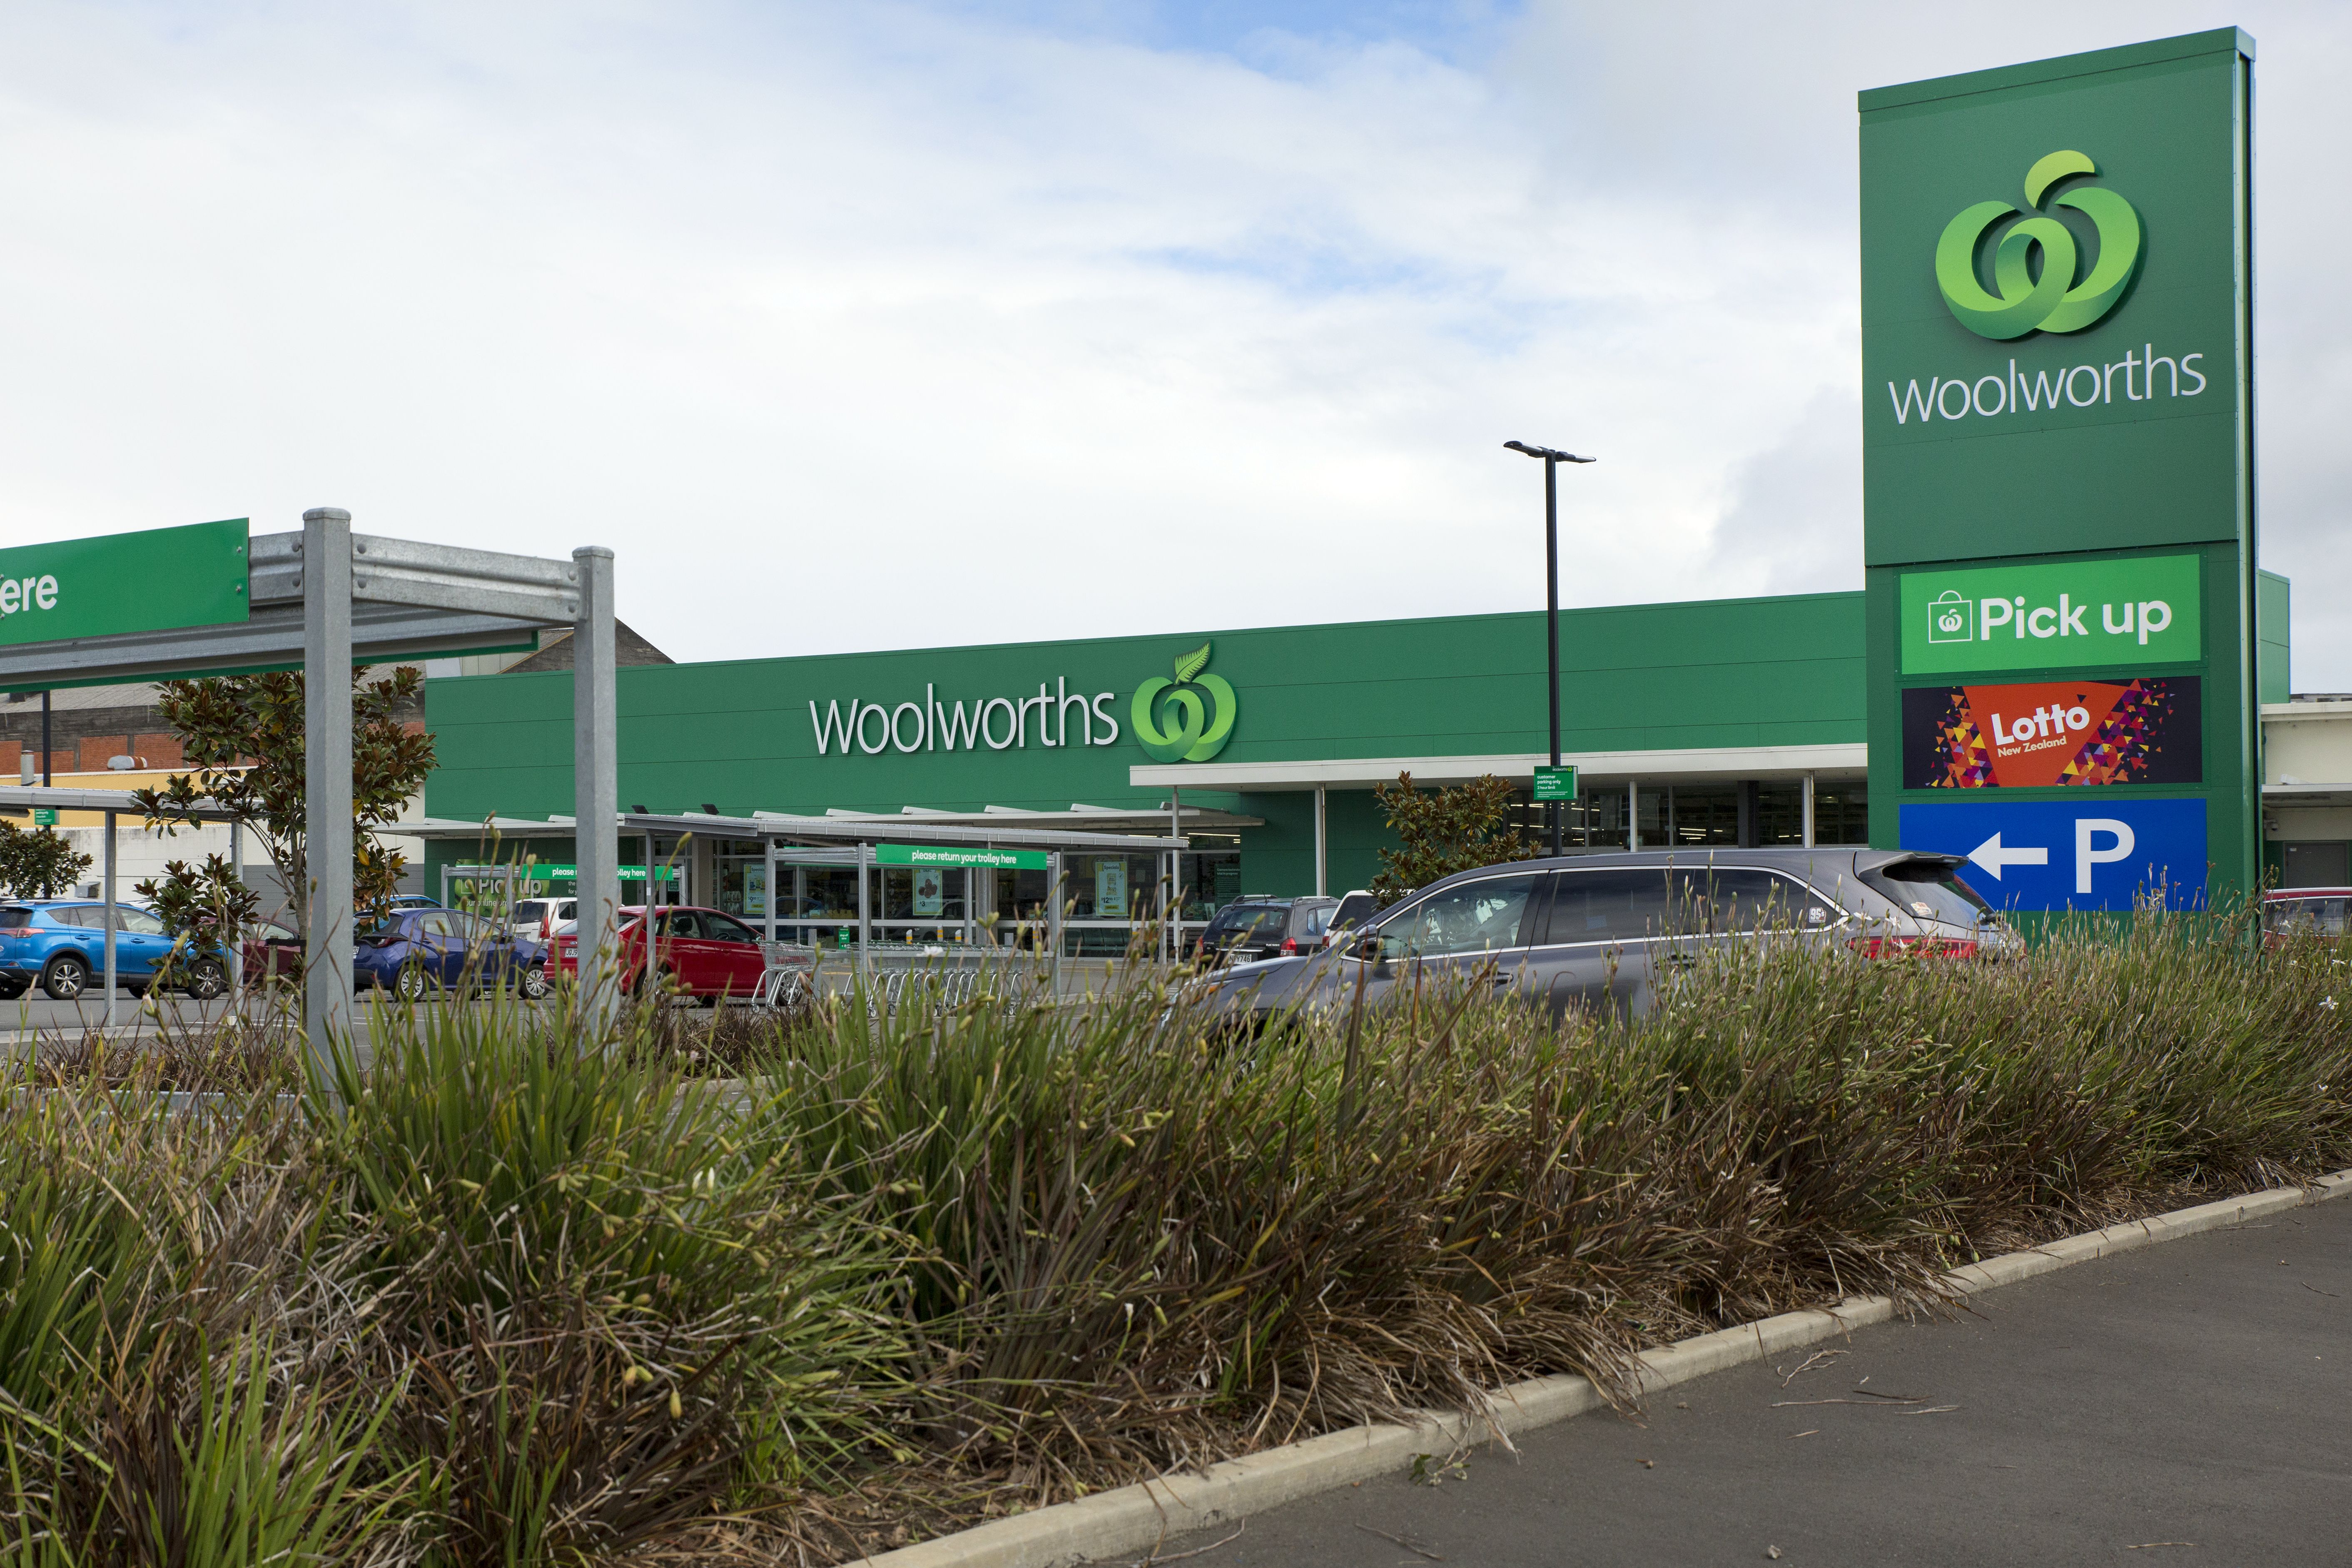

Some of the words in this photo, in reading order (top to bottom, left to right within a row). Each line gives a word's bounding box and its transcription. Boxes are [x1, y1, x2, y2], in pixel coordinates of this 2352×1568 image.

[1888, 344, 2206, 424] Woolworths
[0, 574, 58, 613] ere
[1981, 593, 2089, 641] Pick
[2103, 601, 2172, 645] up
[809, 676, 1119, 754] Woolworths
[1991, 704, 2090, 745] Lotto
[1997, 747, 2021, 757] New
[2023, 735, 2067, 752] Zealand
[552, 868, 574, 877] please
[617, 868, 630, 878] olley
[912, 850, 937, 862] please
[938, 852, 960, 861] return
[961, 854, 977, 864] your
[977, 853, 1000, 865] trolley
[1001, 854, 1017, 864] here
[2075, 819, 2135, 893] P
[479, 879, 507, 894] Pic
